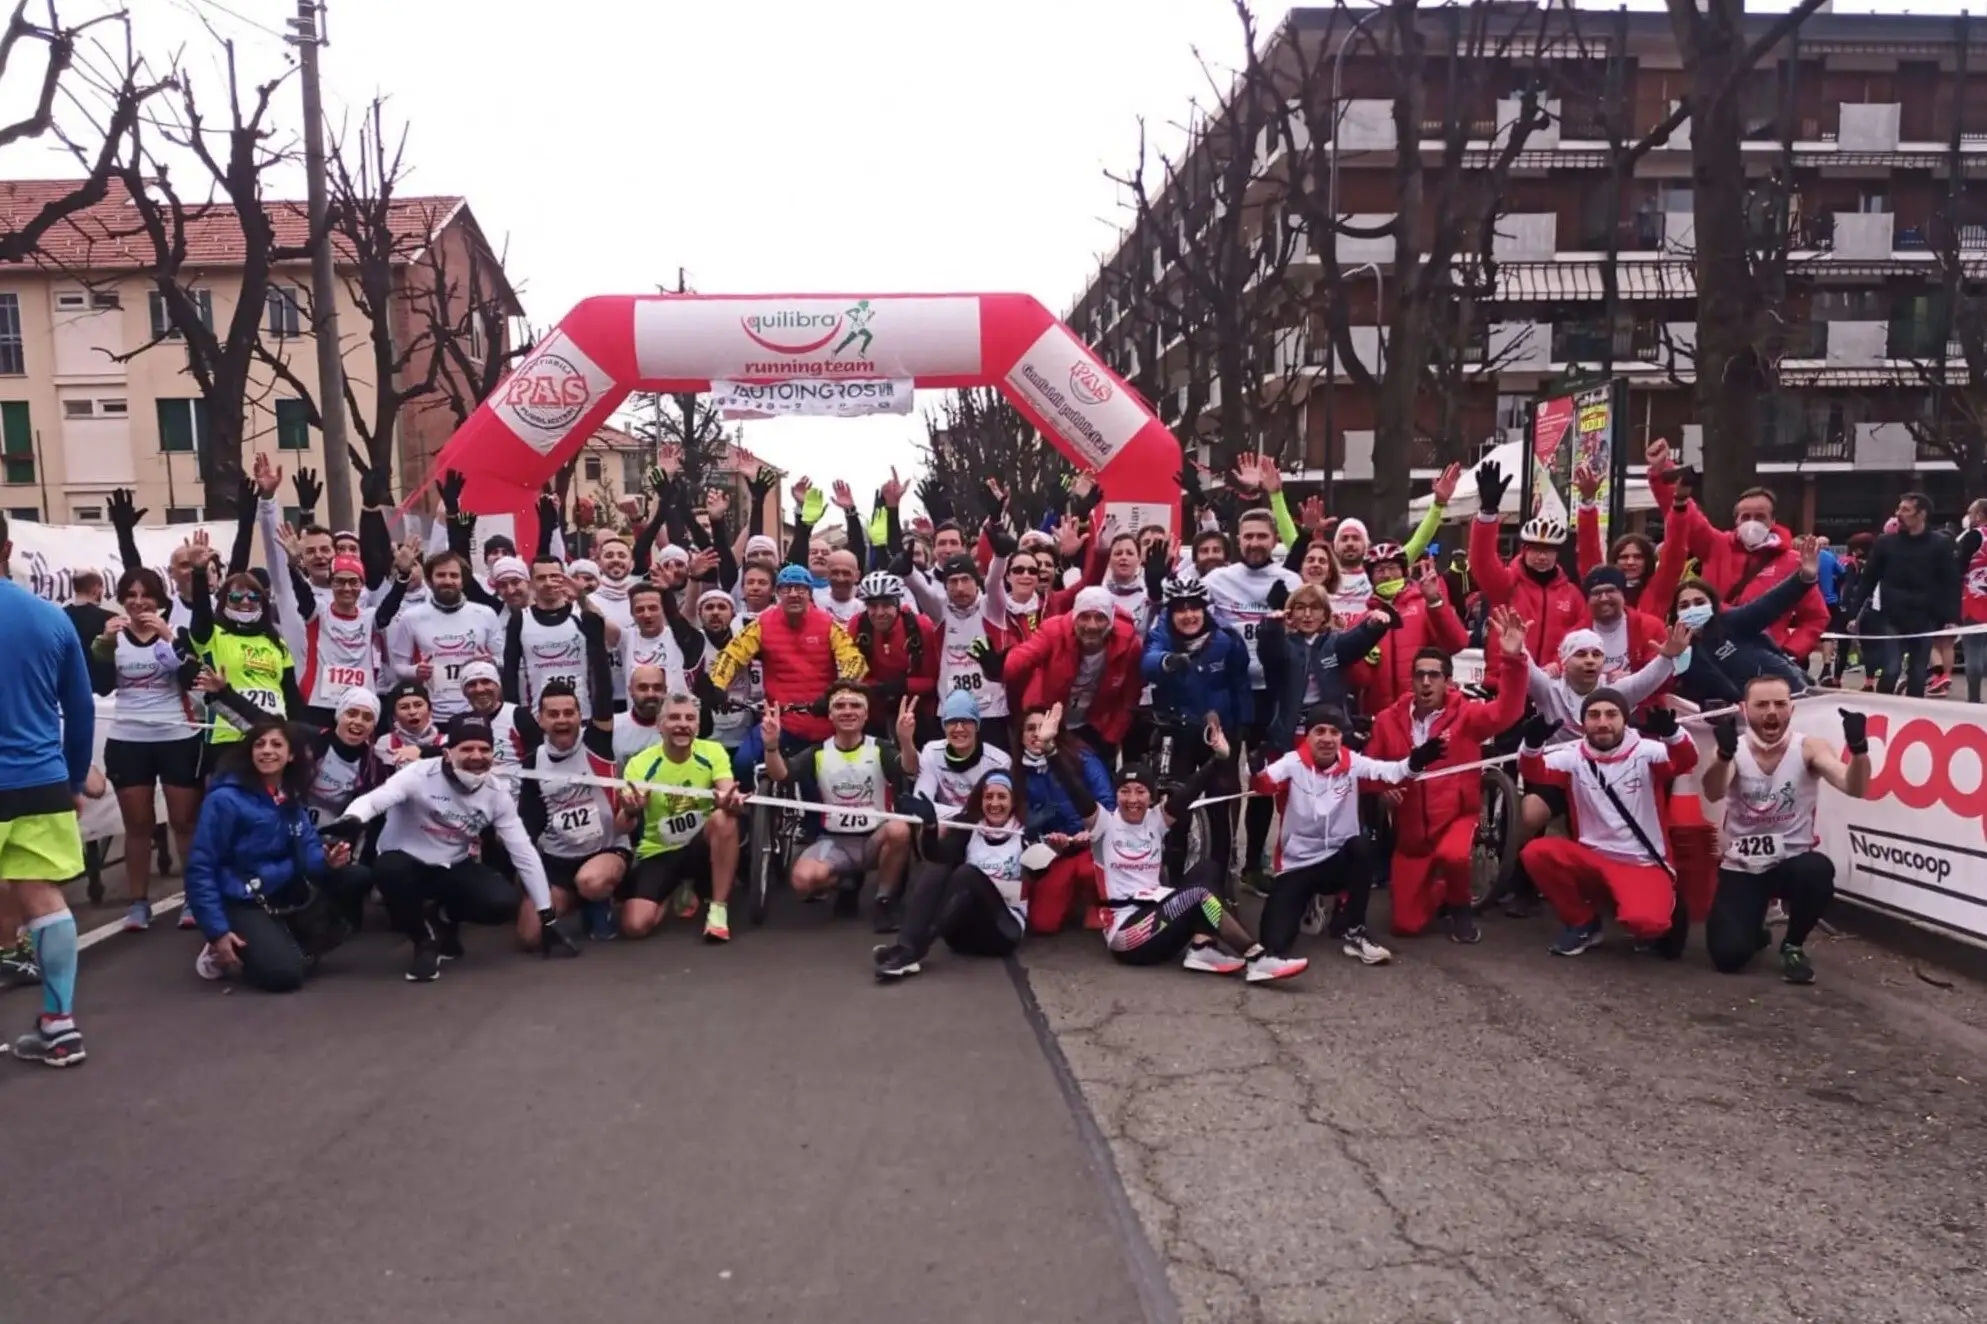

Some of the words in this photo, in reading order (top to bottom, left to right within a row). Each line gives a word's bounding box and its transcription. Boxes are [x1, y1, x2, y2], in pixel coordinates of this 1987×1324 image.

[506, 375, 590, 407] PAS
[328, 667, 365, 687] 1129
[952, 672, 983, 690] 388
[248, 689, 278, 708] 279
[1840, 714, 1987, 844] coo
[560, 808, 591, 831] 212
[666, 812, 697, 835] 100
[1737, 835, 1776, 856] 428
[1849, 831, 1951, 883] Novacoop
